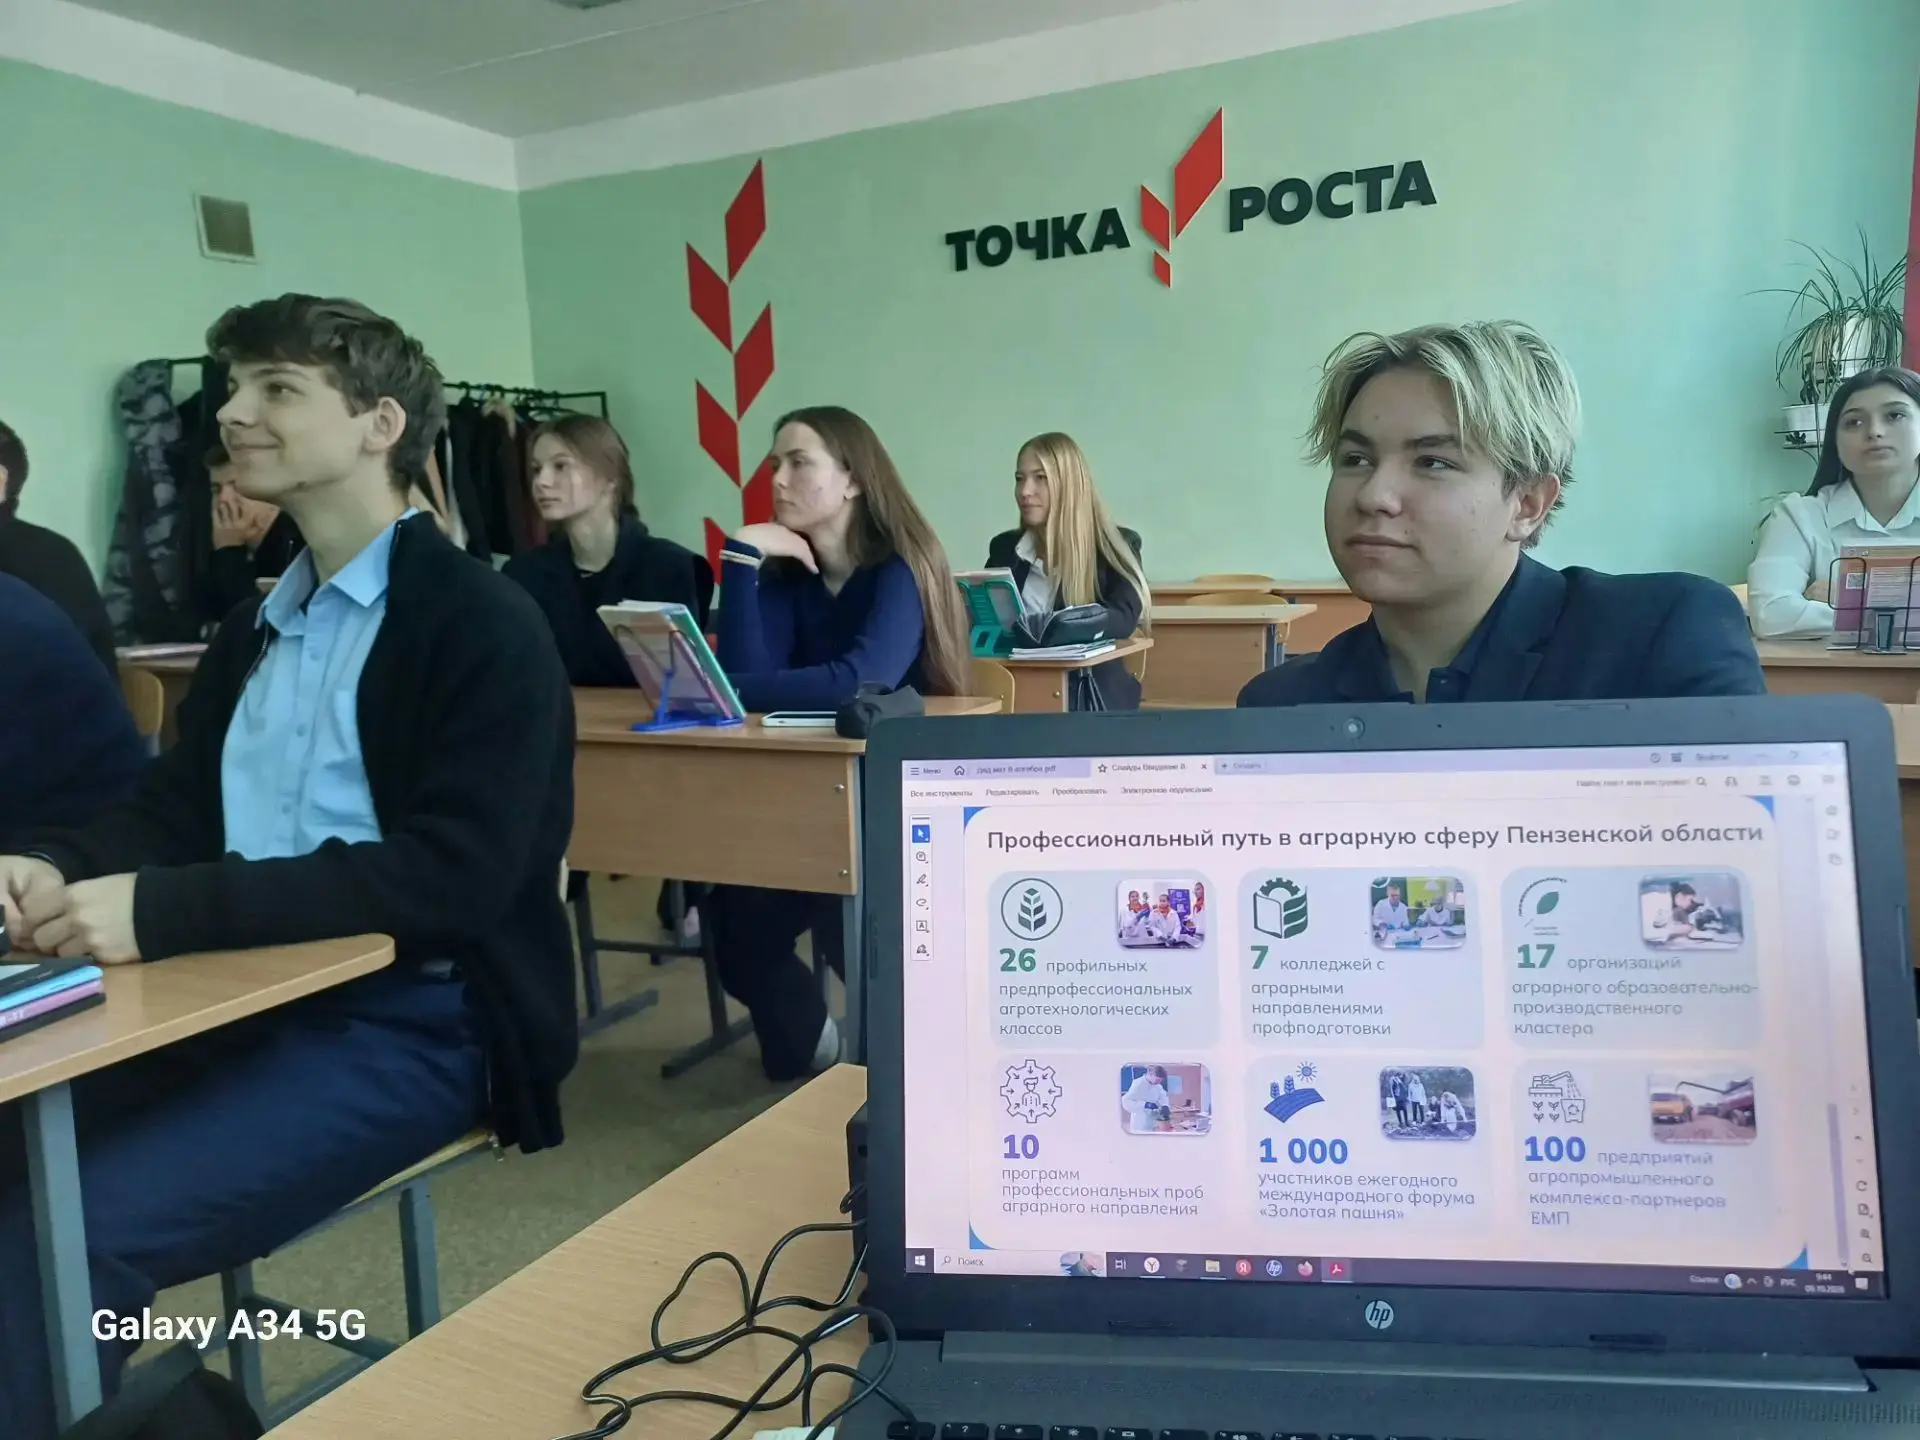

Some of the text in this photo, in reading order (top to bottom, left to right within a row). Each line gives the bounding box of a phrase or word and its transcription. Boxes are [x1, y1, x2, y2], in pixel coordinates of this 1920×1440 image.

[945, 159, 1437, 272] ТОЧКА РОСТА
[910, 790, 925, 798] Все
[987, 822, 1764, 852] Профессиональный путь в аграрную сферу Пензенской области
[1000, 947, 1148, 974] 26 профильных
[1250, 945, 1385, 971] 7 колледжей с
[1517, 943, 1682, 972] 17 организаций
[999, 982, 1193, 998] предпрофессиональных
[1251, 983, 1344, 997] аграрными
[1512, 980, 1759, 997] аграрного образовательно-
[1000, 1004, 1170, 1018] агротехнологических
[1252, 1003, 1383, 1016] направлениями
[1513, 1003, 1683, 1017] производственного
[1000, 1024, 1063, 1035] классов
[1253, 1021, 1391, 1037] профподготовки
[1514, 1024, 1594, 1038] кластера
[1003, 1134, 1040, 1160] 10
[1524, 1136, 1714, 1166] 100 предприятий
[1002, 1168, 1080, 1181] программ
[1258, 1173, 1458, 1188] участников ежегодного
[1529, 1171, 1714, 1188] агропромышленного
[1002, 1183, 1204, 1201] профессиональных проб
[1259, 1189, 1475, 1206] международного форума
[1002, 1202, 1198, 1217] аграрного направления
[1529, 1193, 1726, 1210] комплекса-партнеров
[1260, 1204, 1404, 1220] «Золотая пашня»
[1531, 1211, 1570, 1226] ЕМП
[958, 1257, 984, 1266] Поиск
[1366, 1300, 1393, 1329] hp
